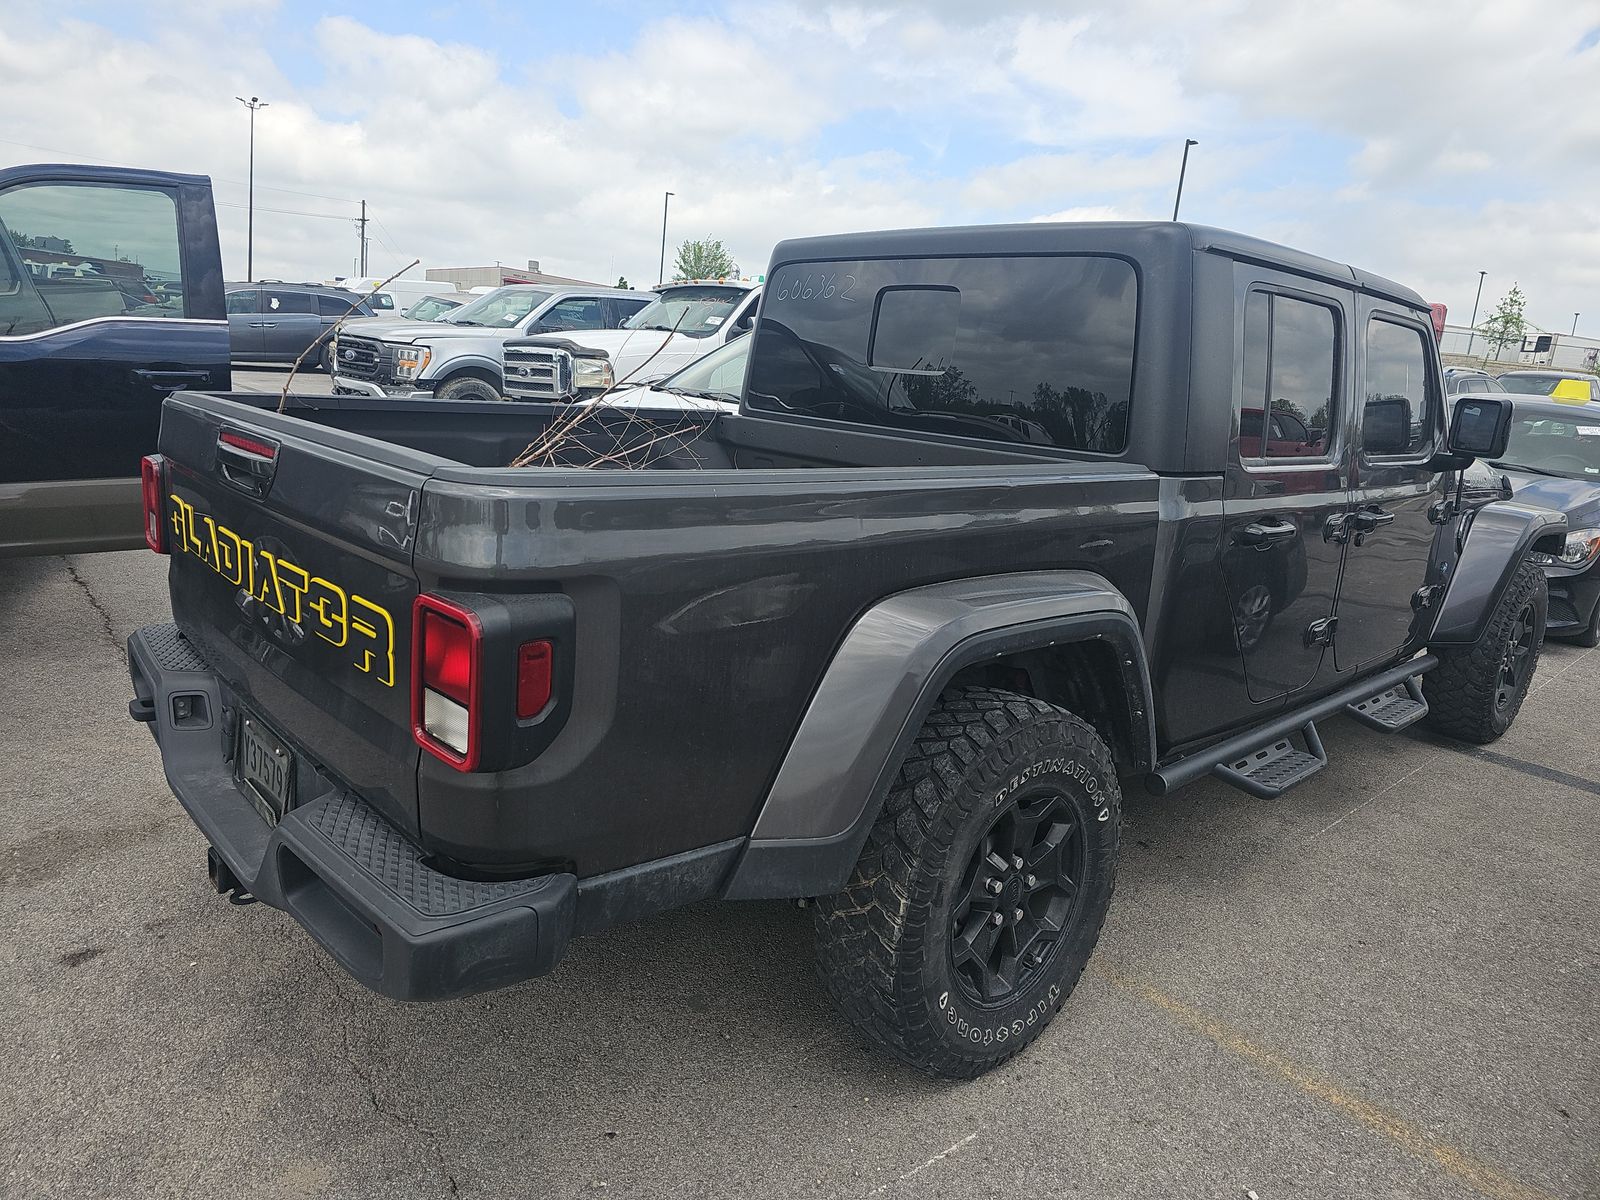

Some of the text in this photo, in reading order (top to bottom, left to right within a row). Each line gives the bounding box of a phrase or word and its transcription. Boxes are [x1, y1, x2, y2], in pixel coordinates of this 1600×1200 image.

[777, 273, 856, 302] 606362
[169, 494, 394, 687] GLADIATOR
[995, 757, 1105, 807] DESTINATION
